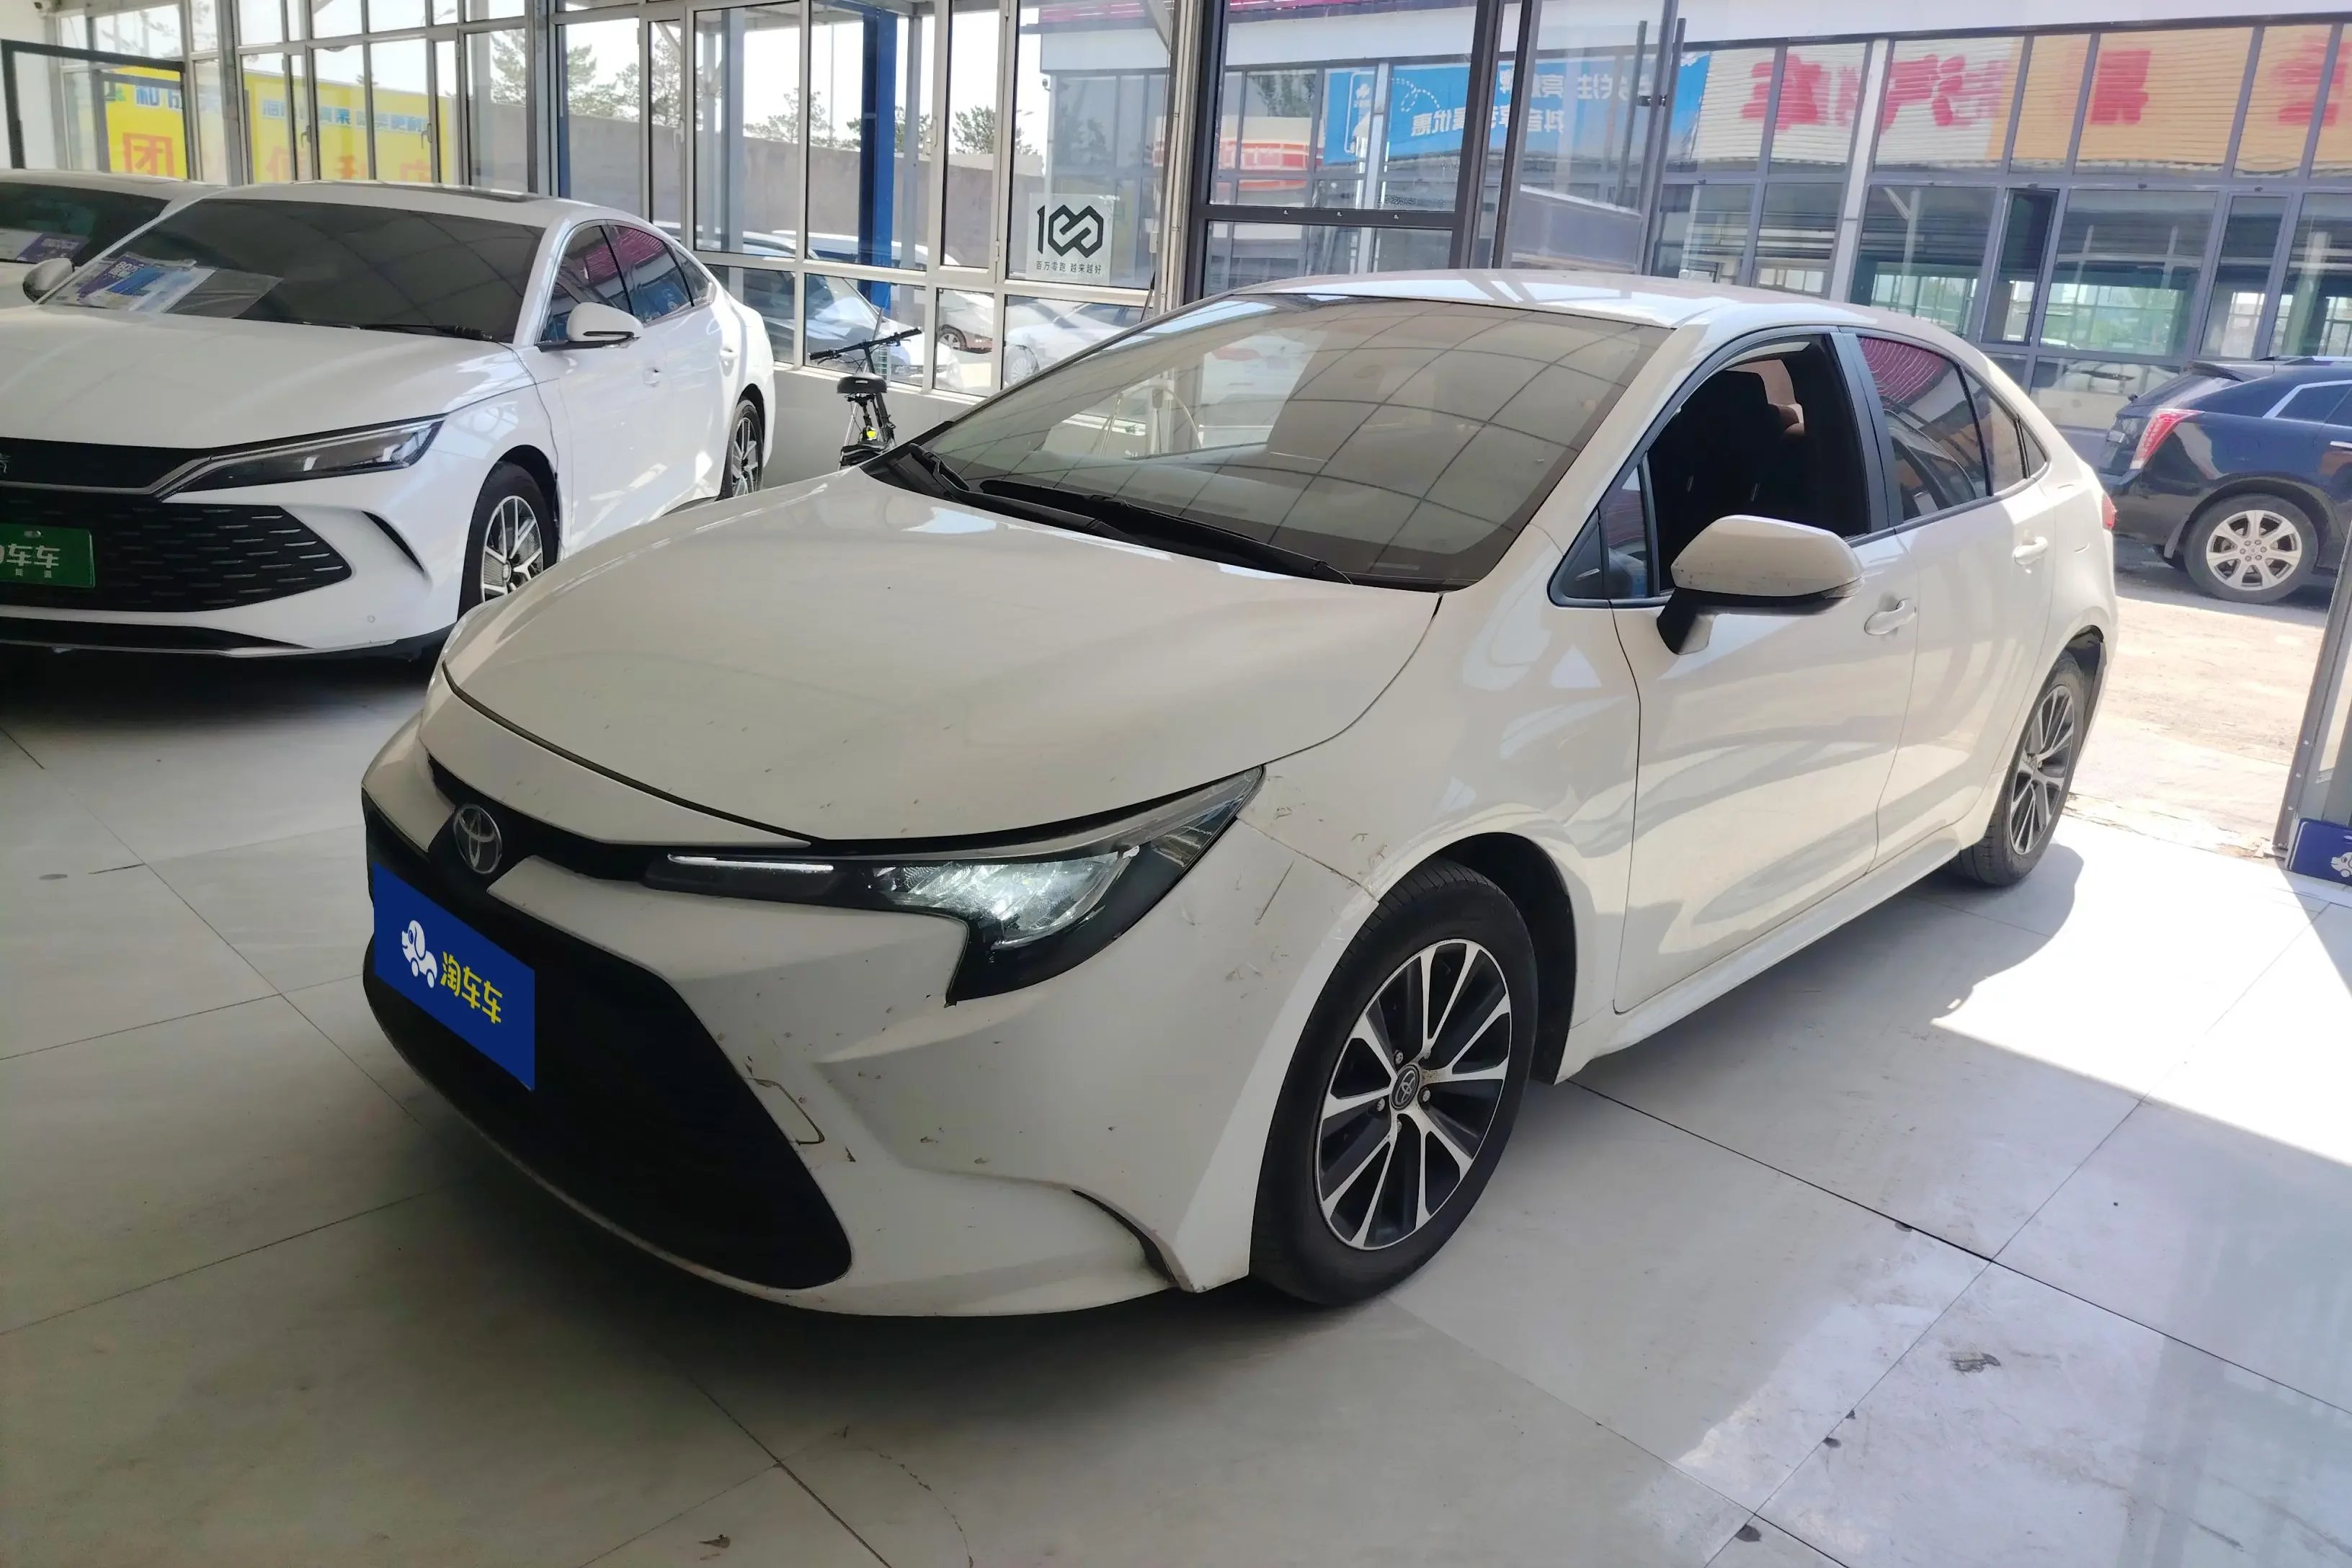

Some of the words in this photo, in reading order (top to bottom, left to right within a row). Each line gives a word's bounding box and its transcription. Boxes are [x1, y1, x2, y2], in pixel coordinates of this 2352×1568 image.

[1036, 260, 1066, 272] 百万零跑
[1071, 263, 1102, 275] 越来越好
[0, 543, 61, 569] 车车
[440, 950, 503, 1025] 淘车车
